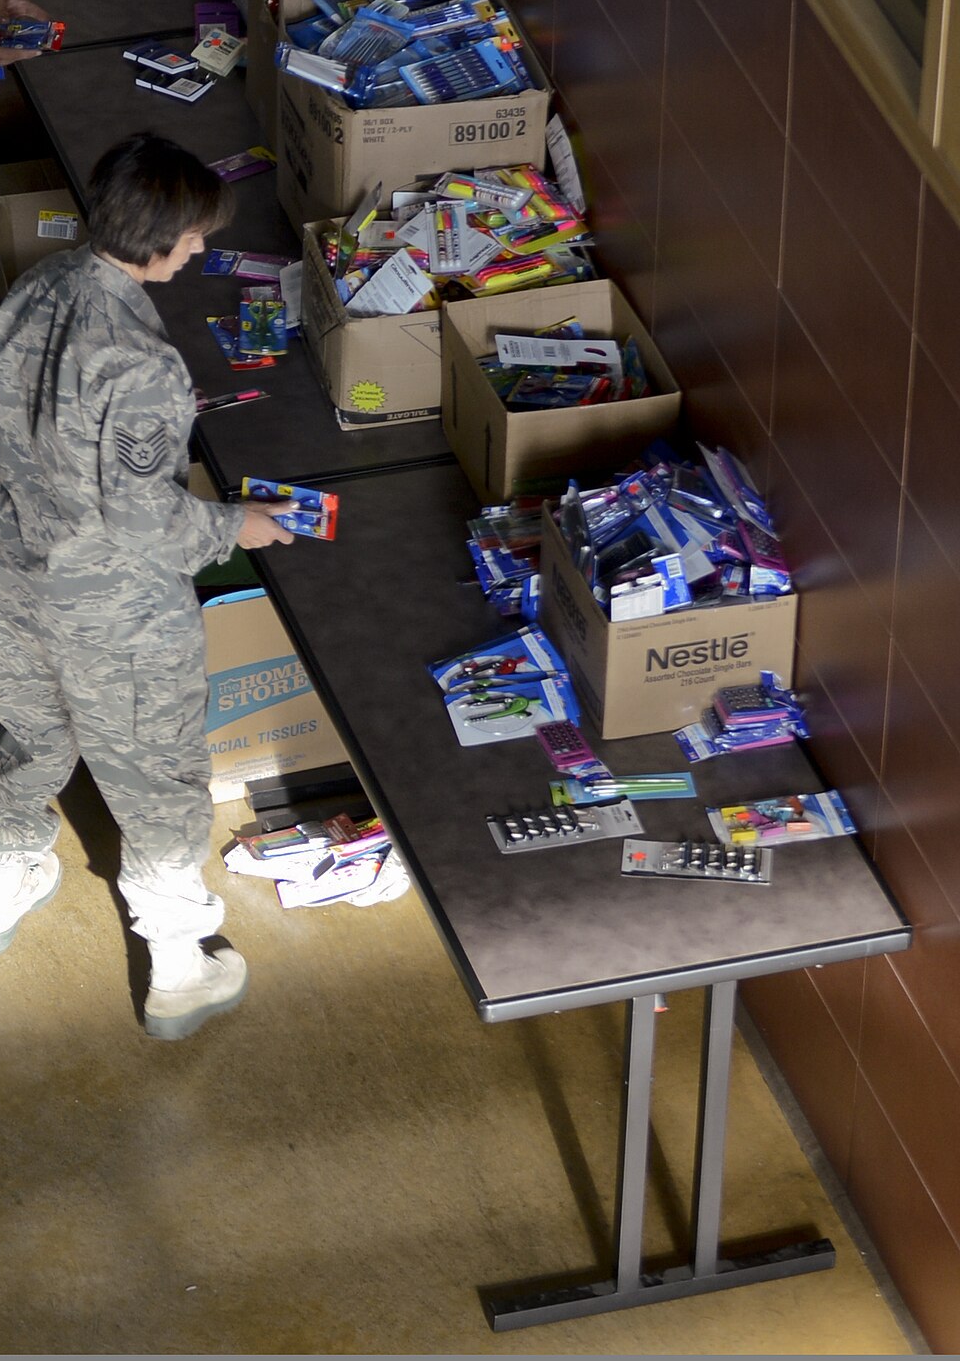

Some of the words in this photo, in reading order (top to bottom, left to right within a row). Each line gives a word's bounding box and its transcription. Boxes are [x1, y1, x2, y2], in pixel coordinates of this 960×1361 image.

[496, 107, 526, 118] 63435
[454, 121, 511, 142] 89100
[515, 119, 526, 137] 2
[386, 409, 428, 421] TAILGATE
[643, 671, 675, 683] Assorted
[676, 667, 711, 679] Chocolate
[713, 662, 734, 673] Single
[735, 659, 752, 669] Bars
[694, 675, 716, 685] Count
[218, 674, 309, 712] STORE
[219, 682, 240, 696] the
[207, 736, 251, 755] ACIAL
[257, 720, 318, 744] TISSUES
